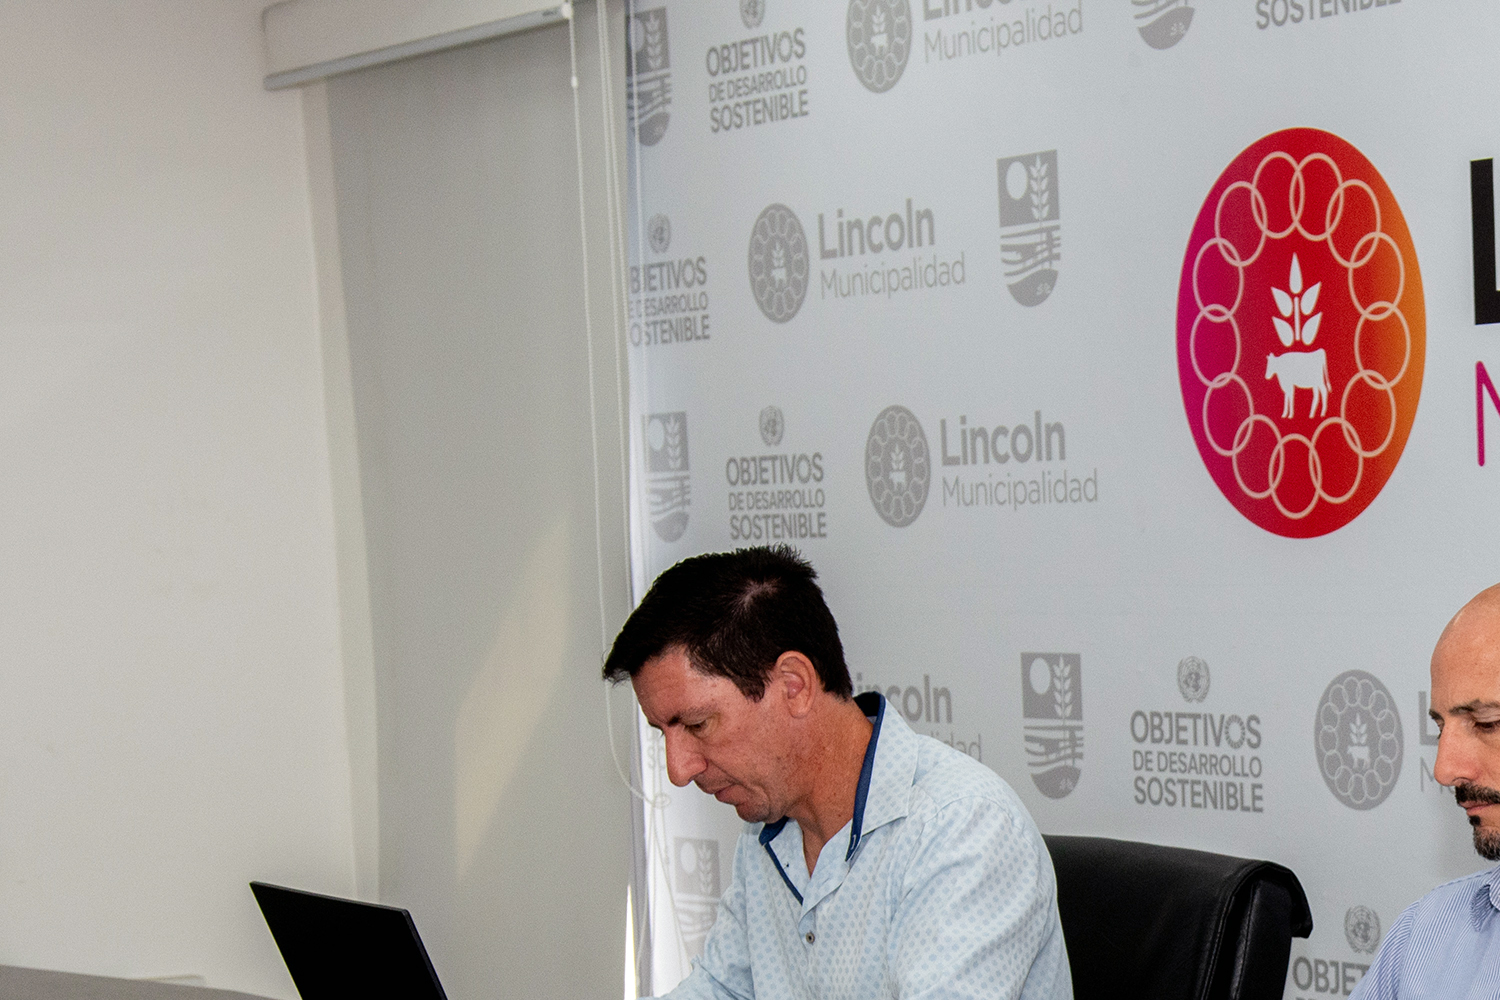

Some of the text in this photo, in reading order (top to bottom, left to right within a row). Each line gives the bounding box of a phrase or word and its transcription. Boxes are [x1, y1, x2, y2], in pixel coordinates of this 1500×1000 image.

[924, 0, 1083, 64] Municipalidad
[706, 27, 806, 77] OBJETIVOS
[709, 65, 807, 104] DE DESARROLLO
[711, 89, 809, 133] SOSTENIBLE
[818, 197, 935, 260] Lincoln
[820, 251, 966, 300] Municipalidad
[630, 314, 710, 347] OSTENIBLE
[940, 409, 1066, 466] Lincoln
[726, 452, 824, 487] OBJETIVOS
[728, 488, 825, 511] DE DESARROLLO
[942, 467, 1099, 512] Municipalidad
[730, 511, 827, 540] SOSTENIBLE
[1130, 710, 1262, 749] OBJETIVOS
[1133, 749, 1263, 778] DE DESARROLLO
[1133, 776, 1264, 813] SOSTENIBLE
